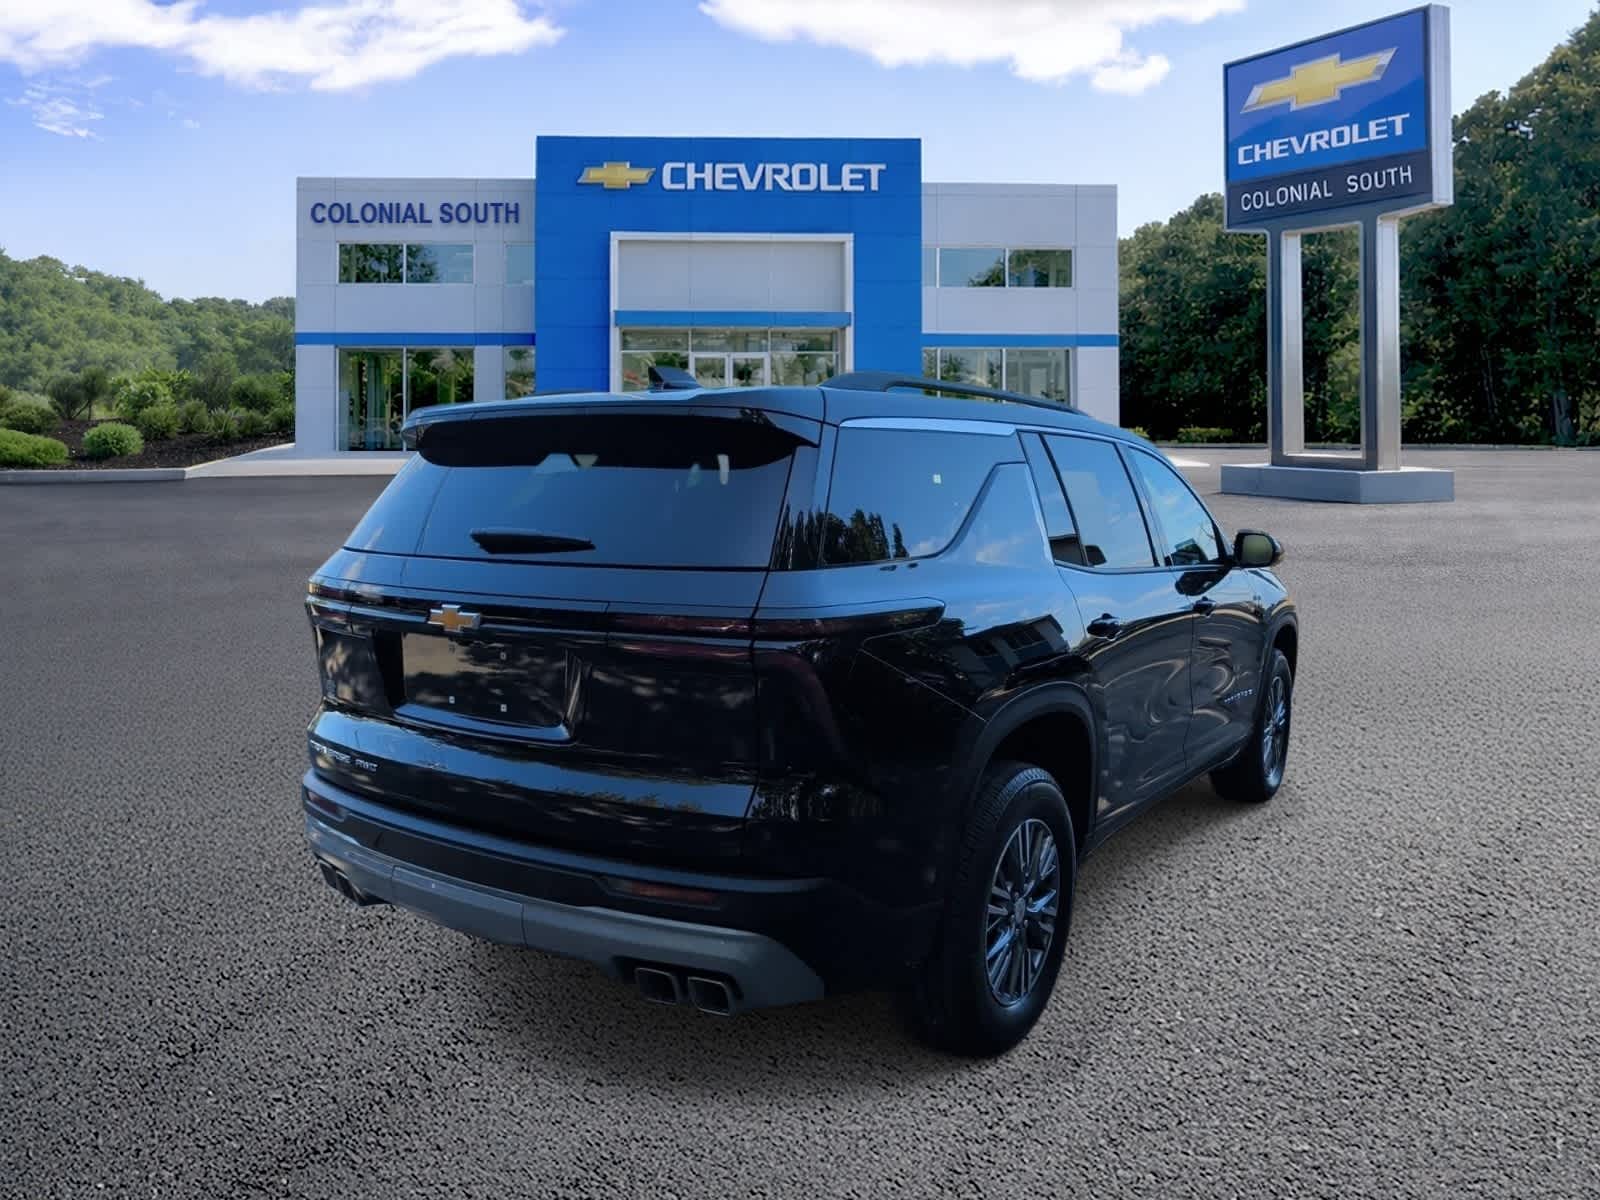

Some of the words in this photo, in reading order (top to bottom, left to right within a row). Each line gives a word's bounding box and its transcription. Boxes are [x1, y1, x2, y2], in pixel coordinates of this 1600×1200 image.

[1238, 113, 1410, 165] CHEVROLET
[662, 162, 886, 191] CHEVROLET
[1241, 180, 1333, 211] COLONIAL
[1347, 165, 1413, 193] SOUTH
[311, 202, 432, 224] COLONIAL
[439, 202, 520, 224] SOUTH
